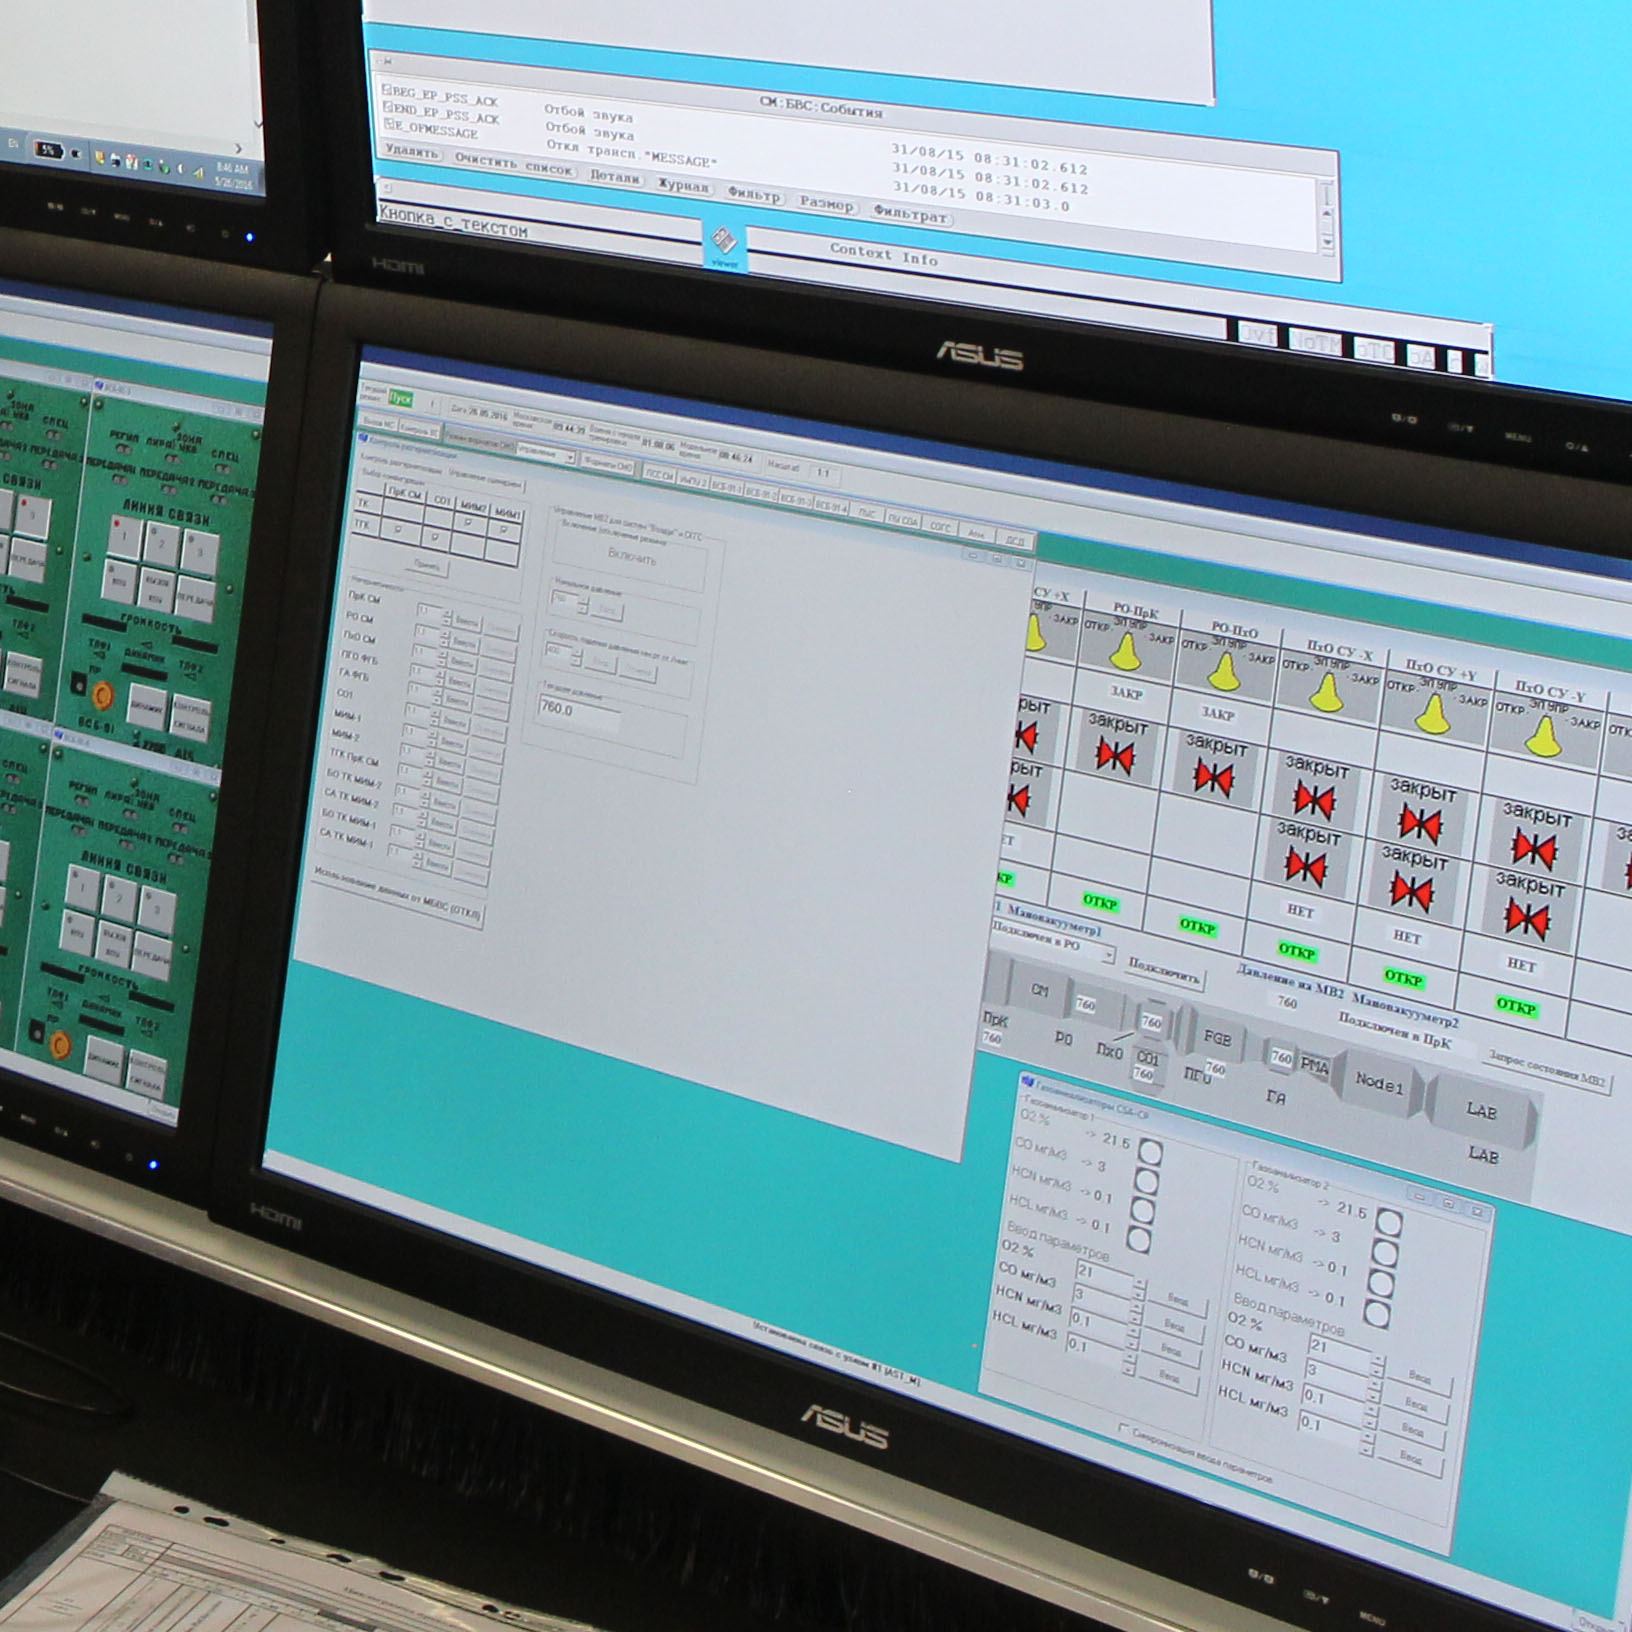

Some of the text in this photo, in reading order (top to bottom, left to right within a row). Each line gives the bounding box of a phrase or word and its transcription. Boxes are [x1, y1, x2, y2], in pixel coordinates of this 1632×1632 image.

[544, 102, 635, 125] Отбой звука
[545, 120, 635, 143] Отбой звука
[385, 141, 439, 161] Удалить
[546, 138, 580, 154] Откл
[455, 150, 574, 178] Очистить список
[891, 141, 1089, 176] 31/08/15 08:31:02.612
[658, 176, 710, 195] Журнал
[892, 160, 1089, 195] 31/08/15 08:31:02.612
[728, 185, 781, 205] Фильтр
[800, 194, 855, 215] Размер
[893, 179, 1071, 213] 31/08/15 08:31:03.0
[830, 242, 939, 268] Context Info
[936, 340, 1025, 372] ASUS
[390, 390, 412, 406] Пуск
[123, 498, 211, 527] ЛИНИЯ СВЯЗИ
[608, 547, 657, 567] Включить
[1113, 602, 1160, 620] РО-ПрК
[1211, 620, 1259, 639] РО-ПхО
[1307, 640, 1336, 655] ПхО
[1338, 646, 1357, 658] СУ
[1406, 658, 1434, 676] ПхО
[1436, 665, 1455, 677] СУ
[1111, 685, 1144, 701] ЗАКР
[1515, 679, 1545, 697] ПхО
[1547, 686, 1567, 698] СУ
[542, 699, 573, 717] 760.0
[1202, 706, 1236, 722] ЗАКР
[1089, 711, 1149, 736] закрыт
[1186, 732, 1249, 758] закрыт
[1286, 753, 1351, 783] закрыт
[1390, 777, 1457, 803] закрыт
[1503, 801, 1573, 828] закрыт
[1277, 821, 1343, 849] закрыт
[1382, 844, 1449, 871] закрыт
[1495, 871, 1567, 898] закрыт
[1083, 893, 1118, 911] ОТКР
[1287, 903, 1315, 919] НЕТ
[1180, 917, 1216, 935] ОТКР
[1064, 937, 1080, 952] РО
[1393, 930, 1423, 946] НЕТ
[1277, 940, 1317, 961] ОТКР
[1507, 957, 1537, 974] НЕТ
[1384, 968, 1424, 987] ОТКР
[1076, 998, 1096, 1013] 760
[1278, 995, 1298, 1009] 760
[1496, 997, 1537, 1016] ОТКР
[983, 1011, 1010, 1028] ПрК
[1142, 1015, 1162, 1029] 760
[1204, 1029, 1233, 1047] FGB
[1423, 1033, 1453, 1050] ПрК
[1356, 1071, 1405, 1095] Node1
[1466, 1100, 1498, 1123] LAB
[1468, 1145, 1500, 1166] LAB
[1007, 1220, 1110, 1263] Ввод параметров
[1020, 1270, 1057, 1288] мг/м3
[996, 1285, 1063, 1315] HCN мг/м3
[993, 1310, 1058, 1340] HCL мг/м3
[800, 1403, 889, 1451] ASUS
